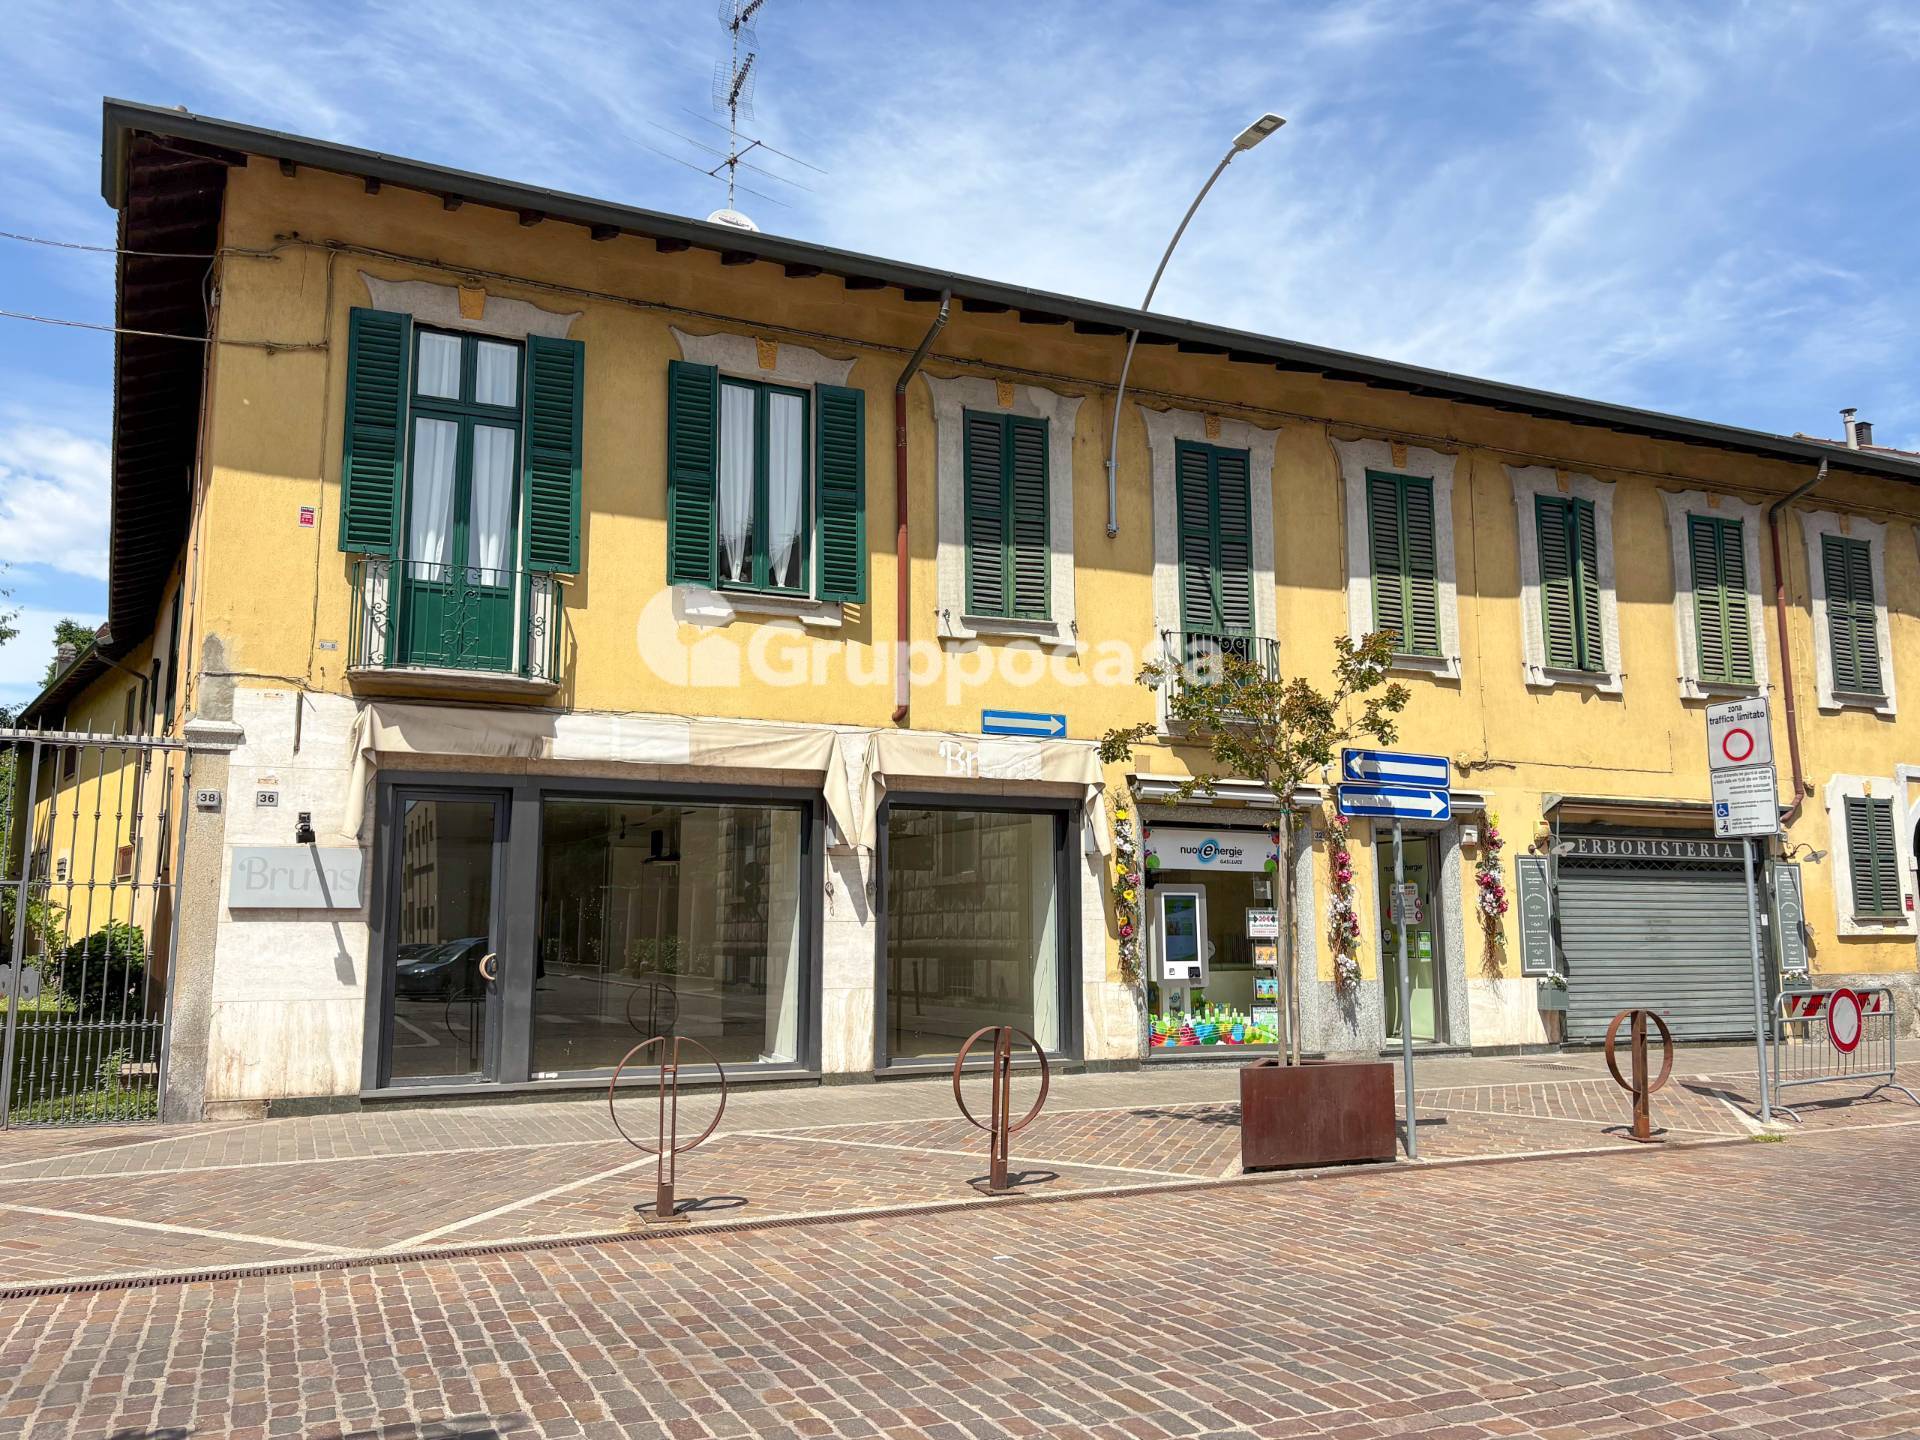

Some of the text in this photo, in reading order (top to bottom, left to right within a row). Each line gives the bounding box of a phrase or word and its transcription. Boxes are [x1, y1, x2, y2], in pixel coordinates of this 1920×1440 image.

[1728, 704, 1743, 713] zona
[1709, 710, 1765, 725] traffico limitato
[199, 793, 216, 802] 38
[259, 794, 275, 803] 36
[1180, 845, 1243, 858] nuovenergie
[1578, 838, 1734, 858] ERBORISTERIA
